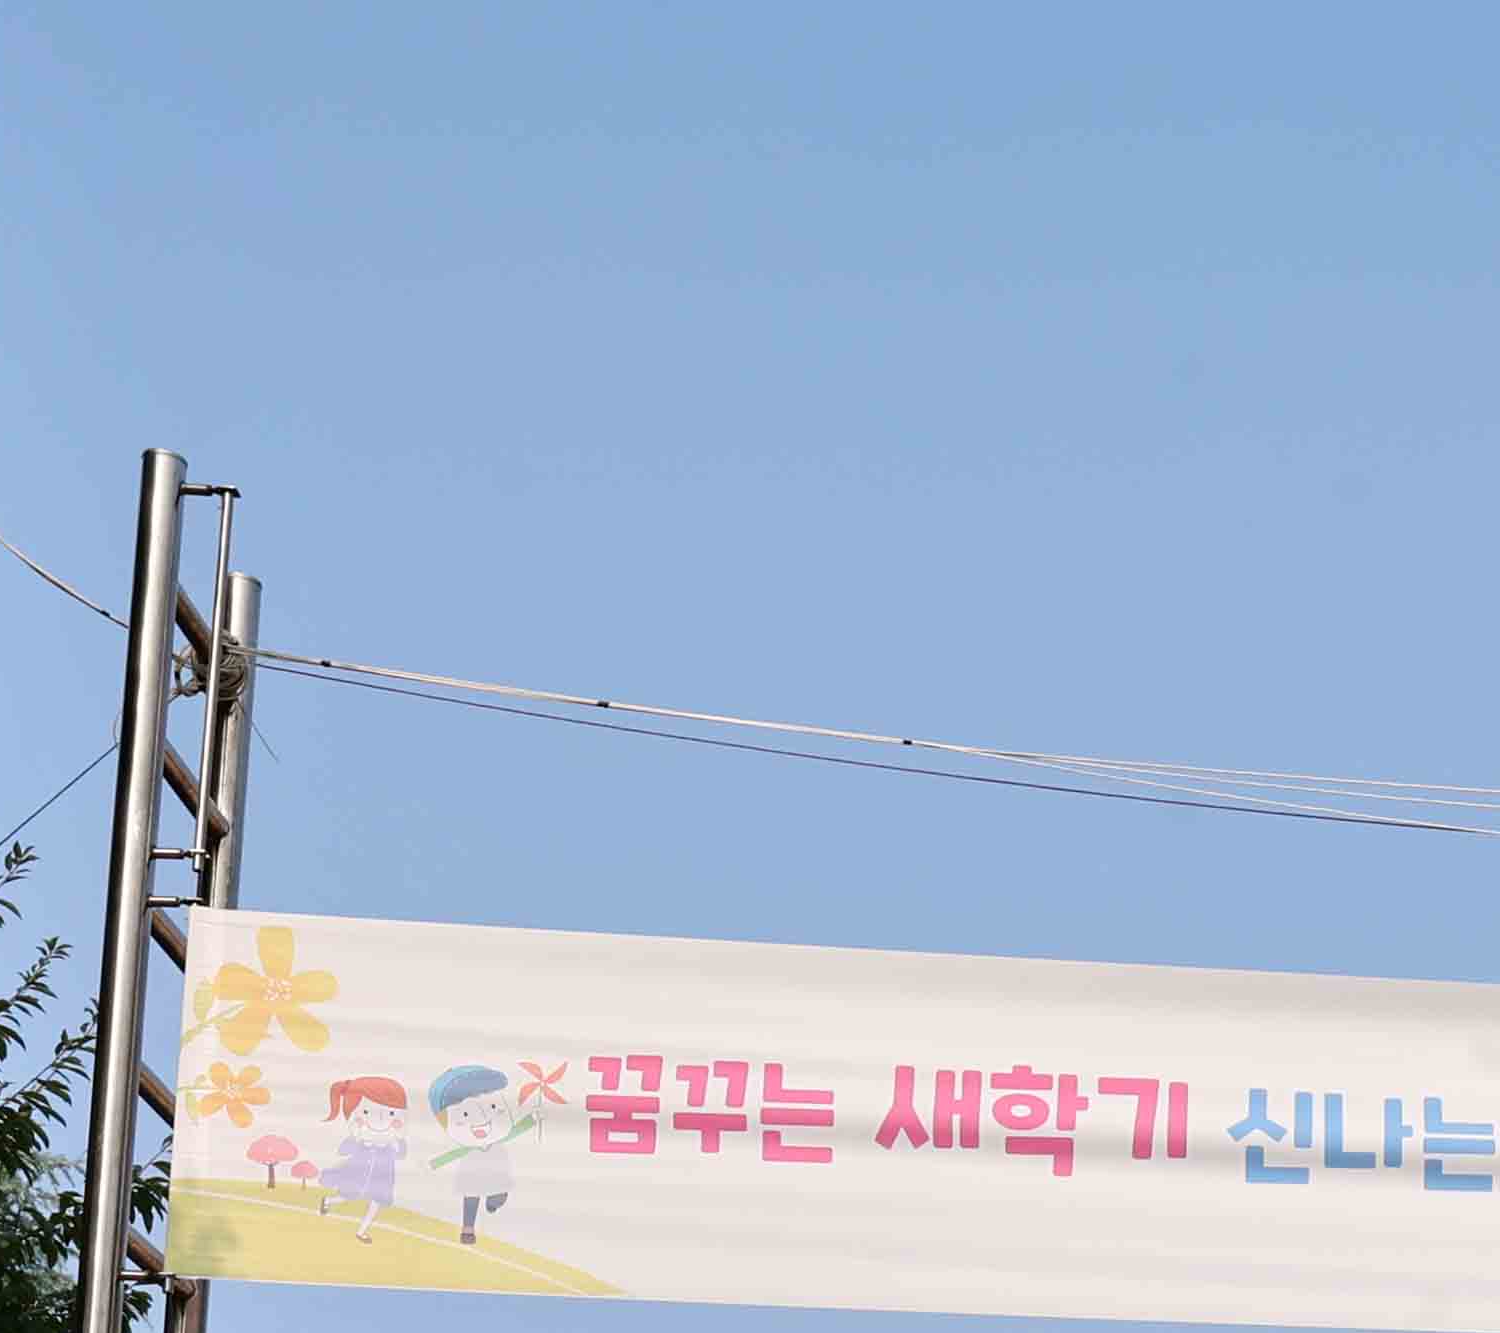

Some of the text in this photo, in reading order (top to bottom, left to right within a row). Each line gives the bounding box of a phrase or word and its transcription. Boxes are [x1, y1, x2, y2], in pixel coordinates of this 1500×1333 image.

[585, 1054, 837, 1166] 꿈꾸는
[875, 1063, 1191, 1180] 새학기
[1224, 1083, 1498, 1196] 신나는
